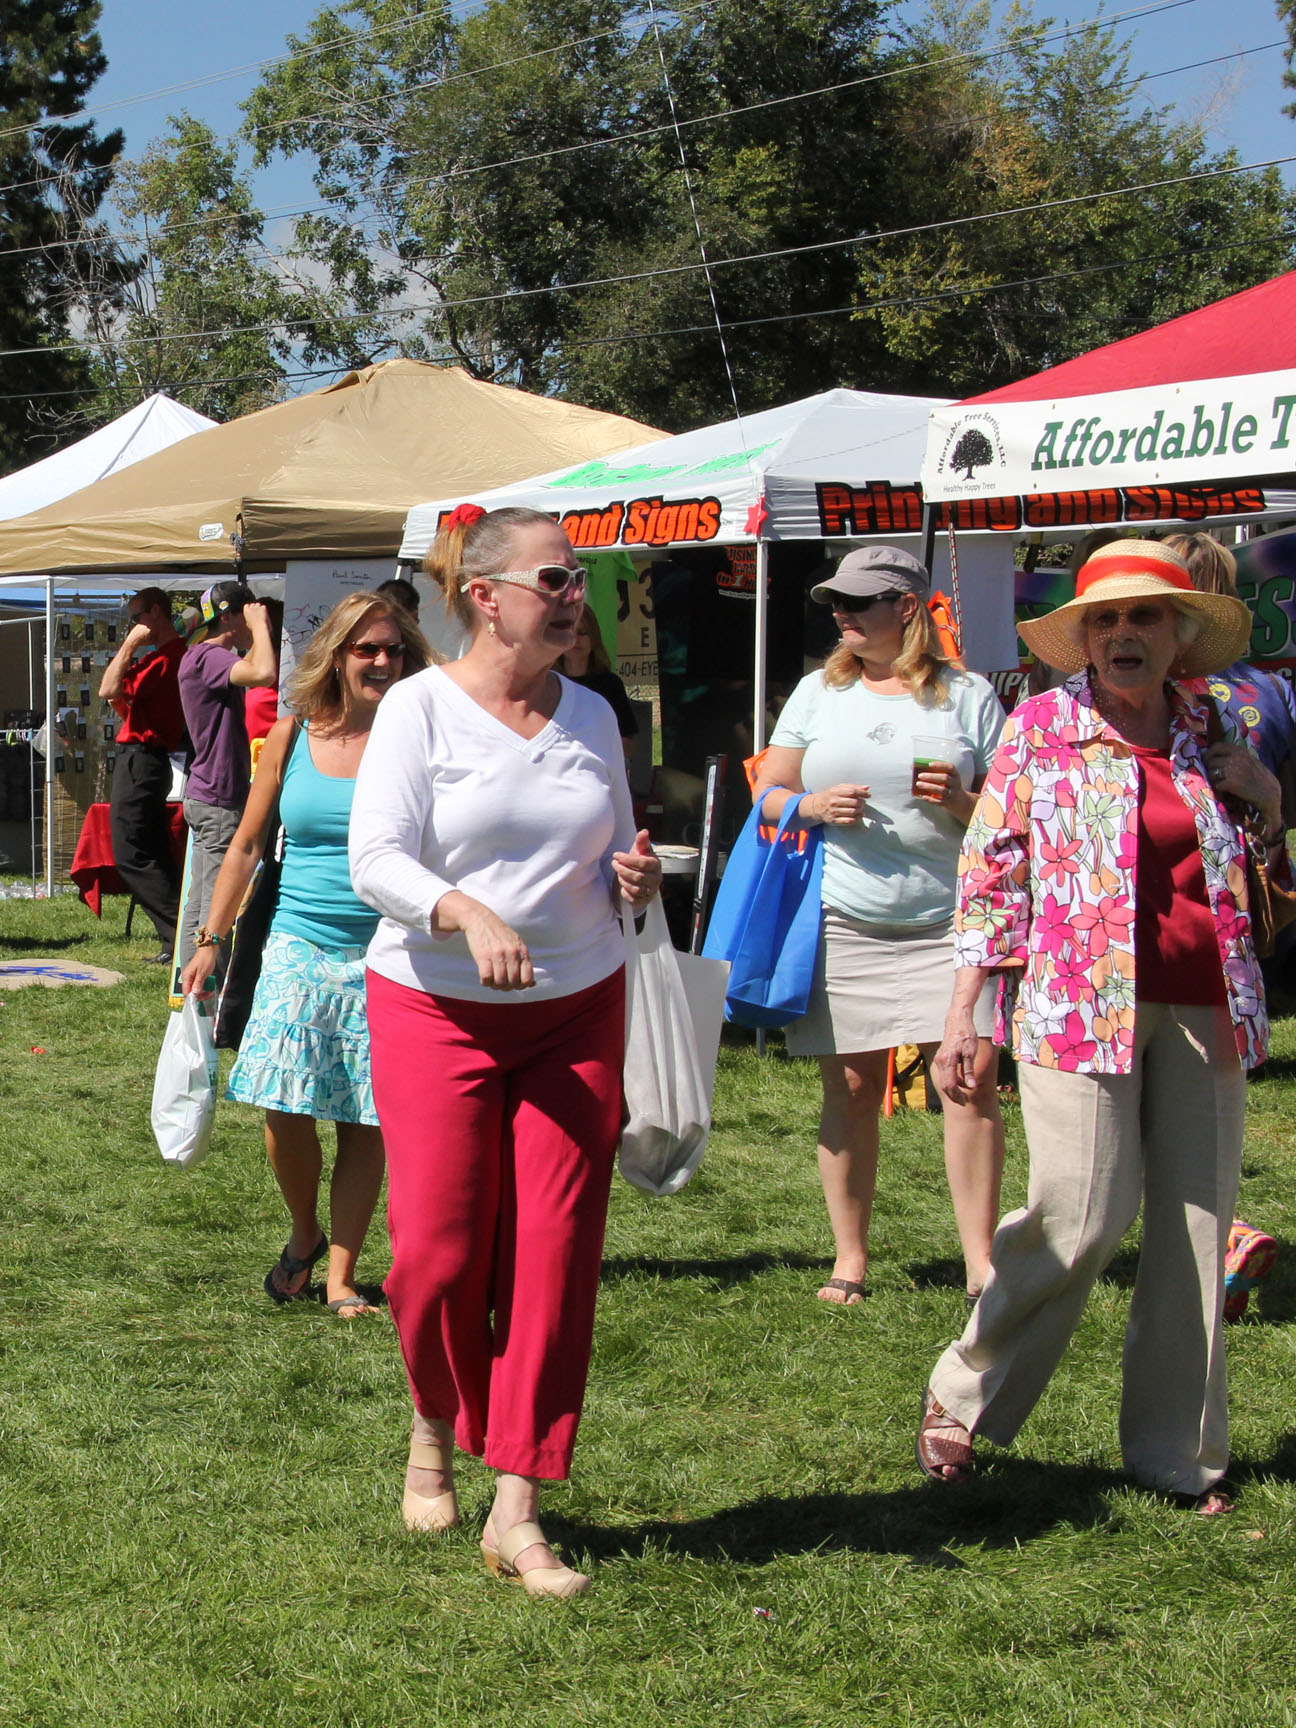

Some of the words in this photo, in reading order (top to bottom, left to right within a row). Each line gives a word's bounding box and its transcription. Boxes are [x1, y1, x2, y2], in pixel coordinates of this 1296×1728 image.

[937, 419, 962, 474] Affordable
[964, 413, 983, 422] Tree
[998, 446, 1007, 468] LLC
[1031, 401, 1258, 471] Affordable
[1269, 394, 1296, 450] T
[819, 483, 1020, 534] Prining
[943, 485, 963, 494] Healthy
[964, 482, 981, 493] Happy
[982, 481, 996, 490] Trees
[562, 502, 624, 549] and
[624, 496, 720, 547] Signs
